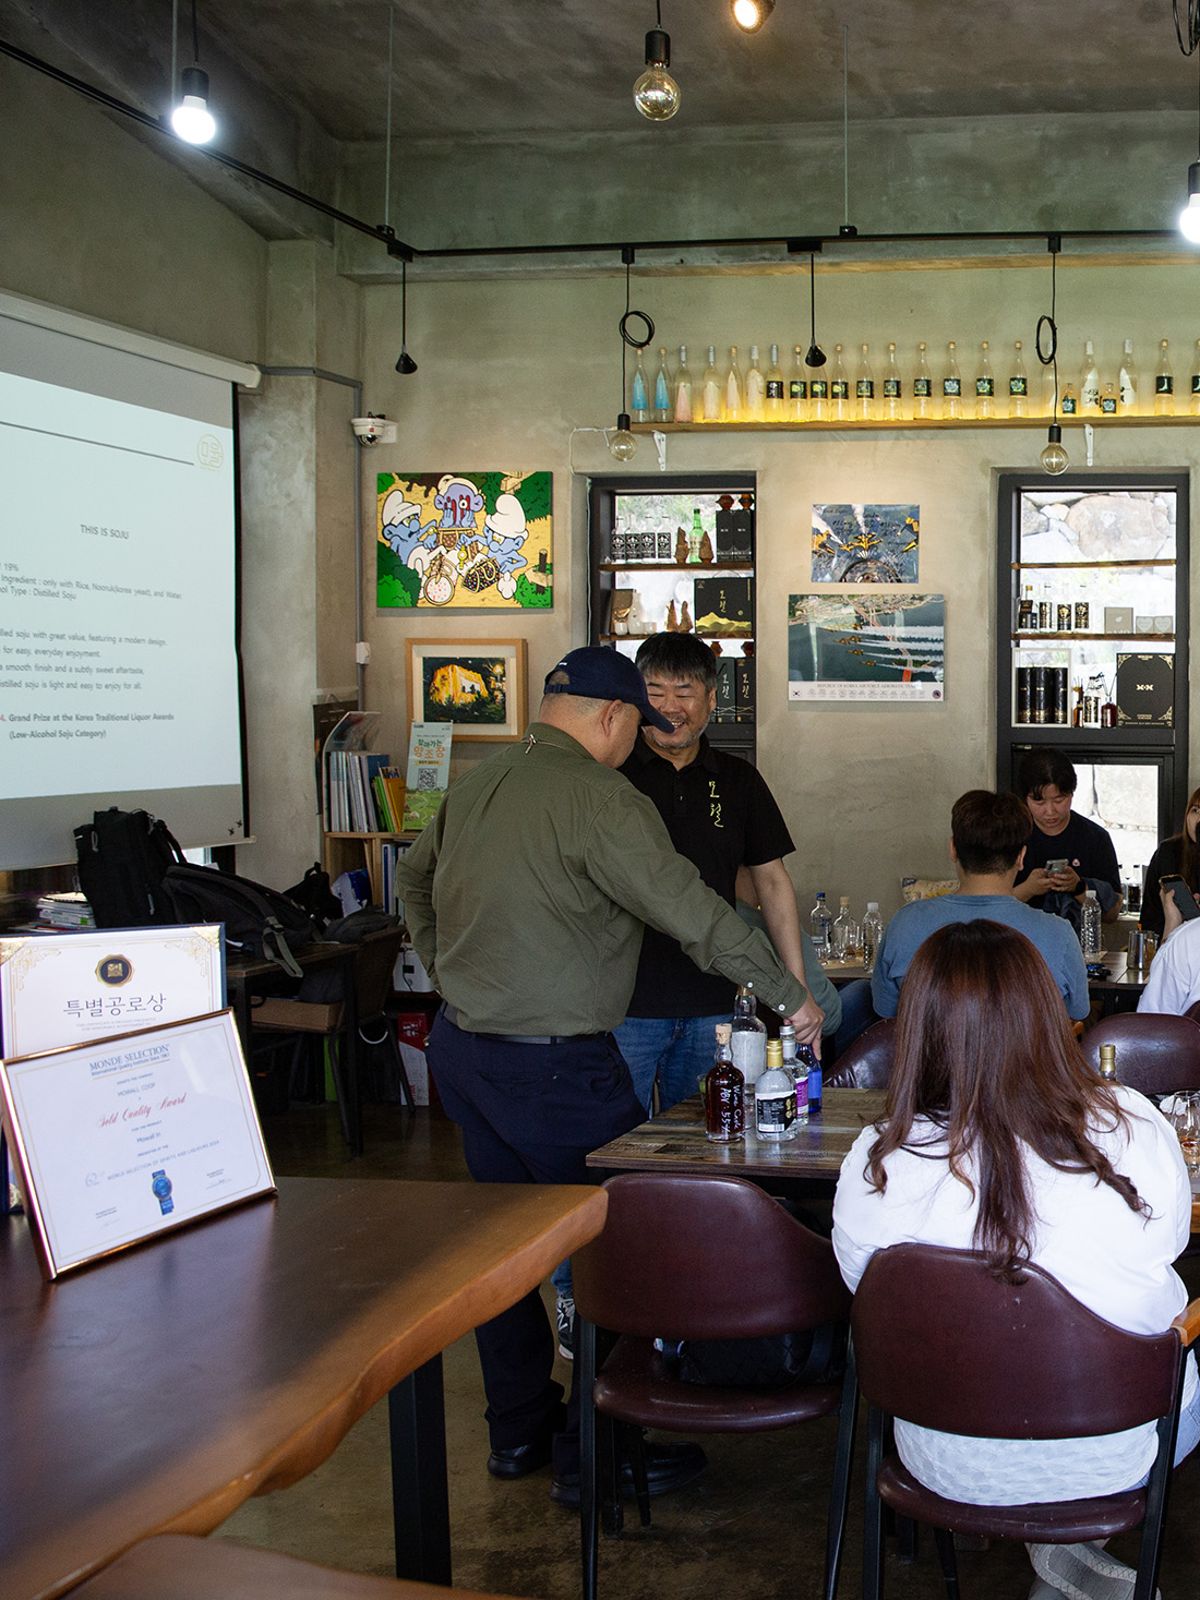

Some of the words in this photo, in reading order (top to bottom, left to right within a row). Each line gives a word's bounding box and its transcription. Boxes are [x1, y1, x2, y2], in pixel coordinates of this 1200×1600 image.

[80, 524, 99, 536] THIS
[101, 527, 108, 537] IS
[110, 529, 129, 540] SOJU
[11, 585, 27, 595] Type
[9, 714, 31, 722] Grand
[33, 713, 51, 722] Prize
[62, 714, 73, 722] the
[63, 992, 167, 1019] 특별공로상
[89, 1054, 122, 1071] MONDE
[124, 1044, 169, 1064] SELECTION
